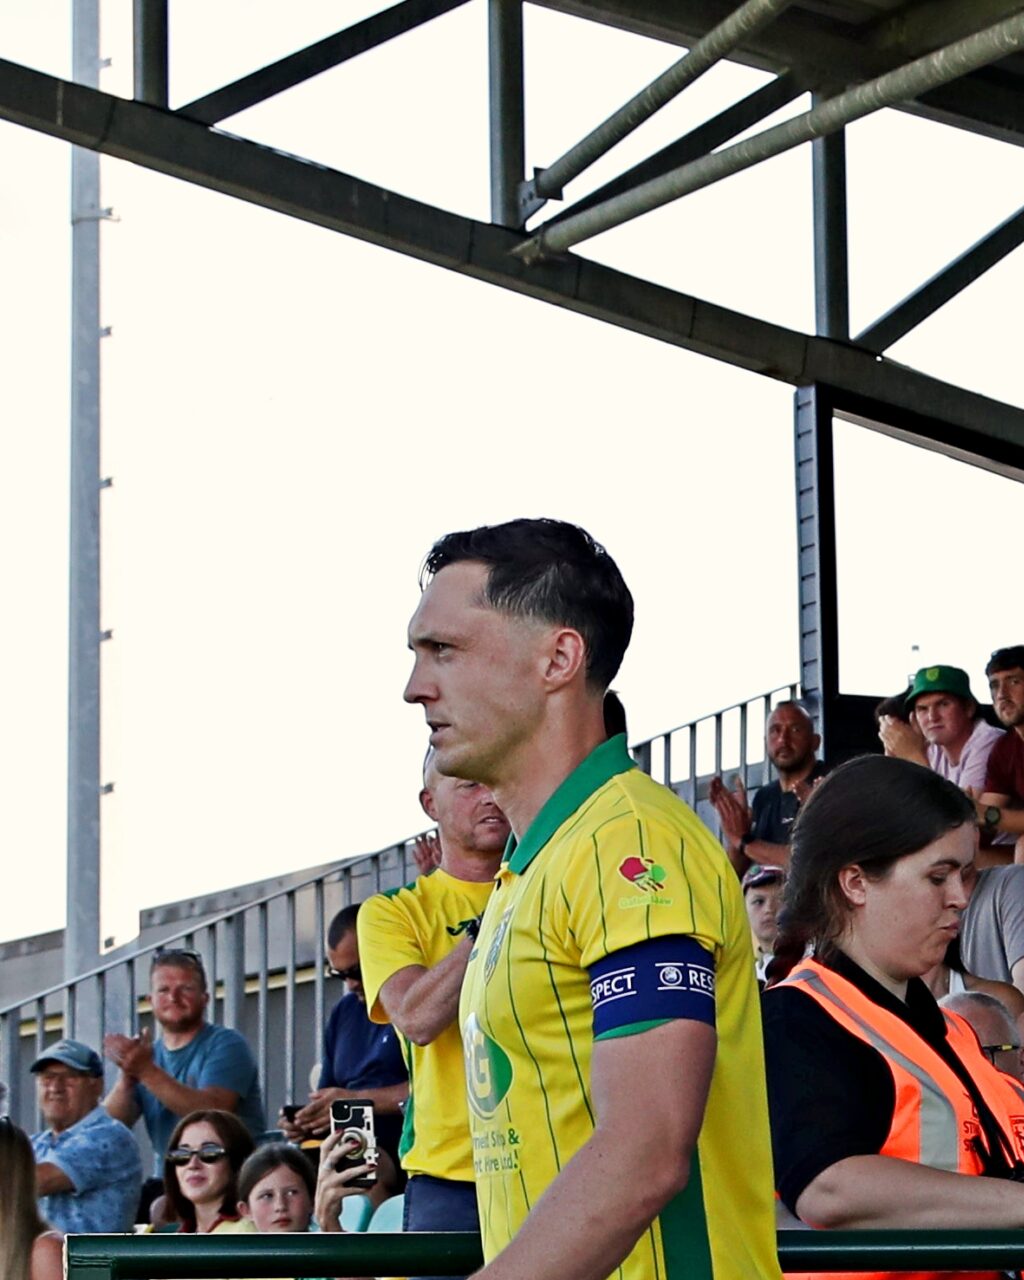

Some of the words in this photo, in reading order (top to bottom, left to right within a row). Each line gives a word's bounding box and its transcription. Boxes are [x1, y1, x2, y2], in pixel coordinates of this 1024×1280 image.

[591, 973, 635, 1002] SPECT
[473, 1030, 491, 1099] G
[508, 1128, 520, 1145] &
